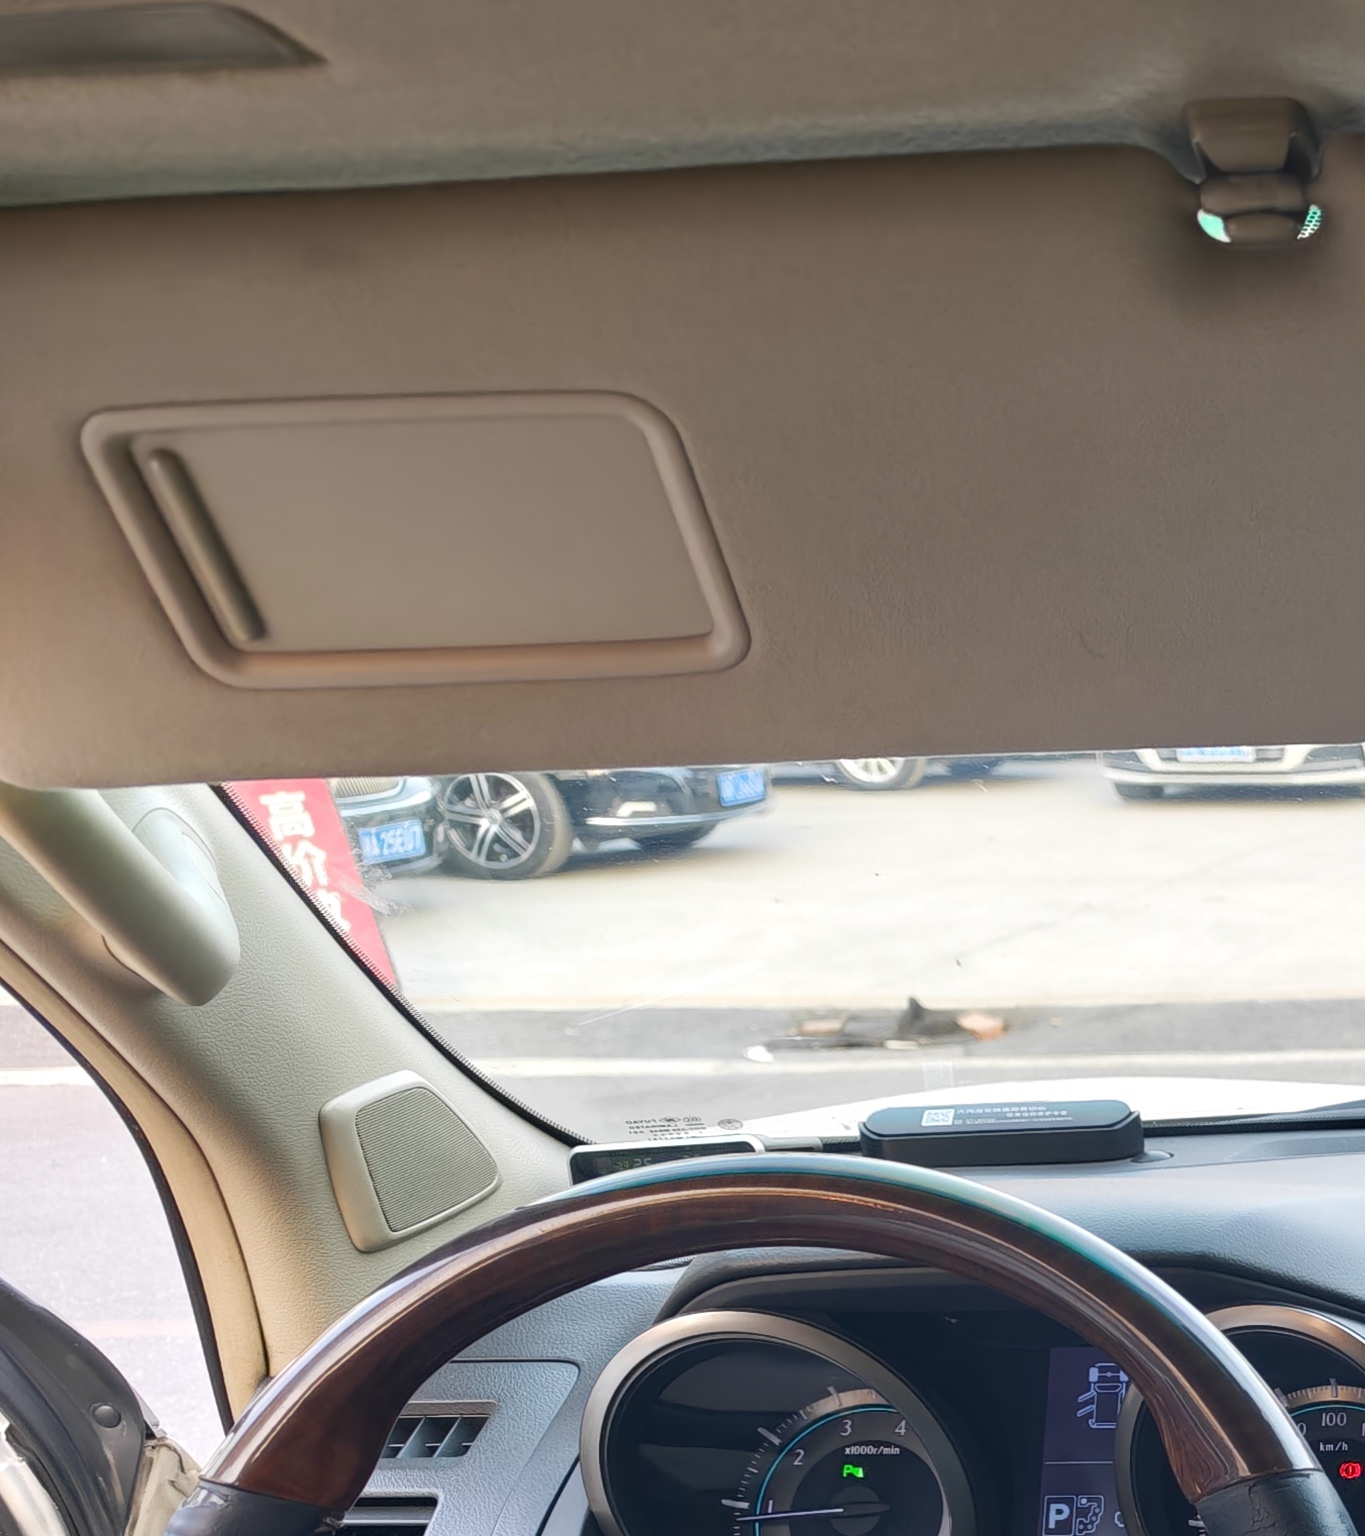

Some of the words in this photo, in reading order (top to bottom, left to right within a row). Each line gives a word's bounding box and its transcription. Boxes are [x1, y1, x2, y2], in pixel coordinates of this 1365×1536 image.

[1321, 1412, 1347, 1427] 100
[840, 1420, 852, 1436] 3
[895, 1420, 907, 1436] 4
[1319, 1442, 1349, 1452] km/h
[793, 1449, 805, 1466] 2
